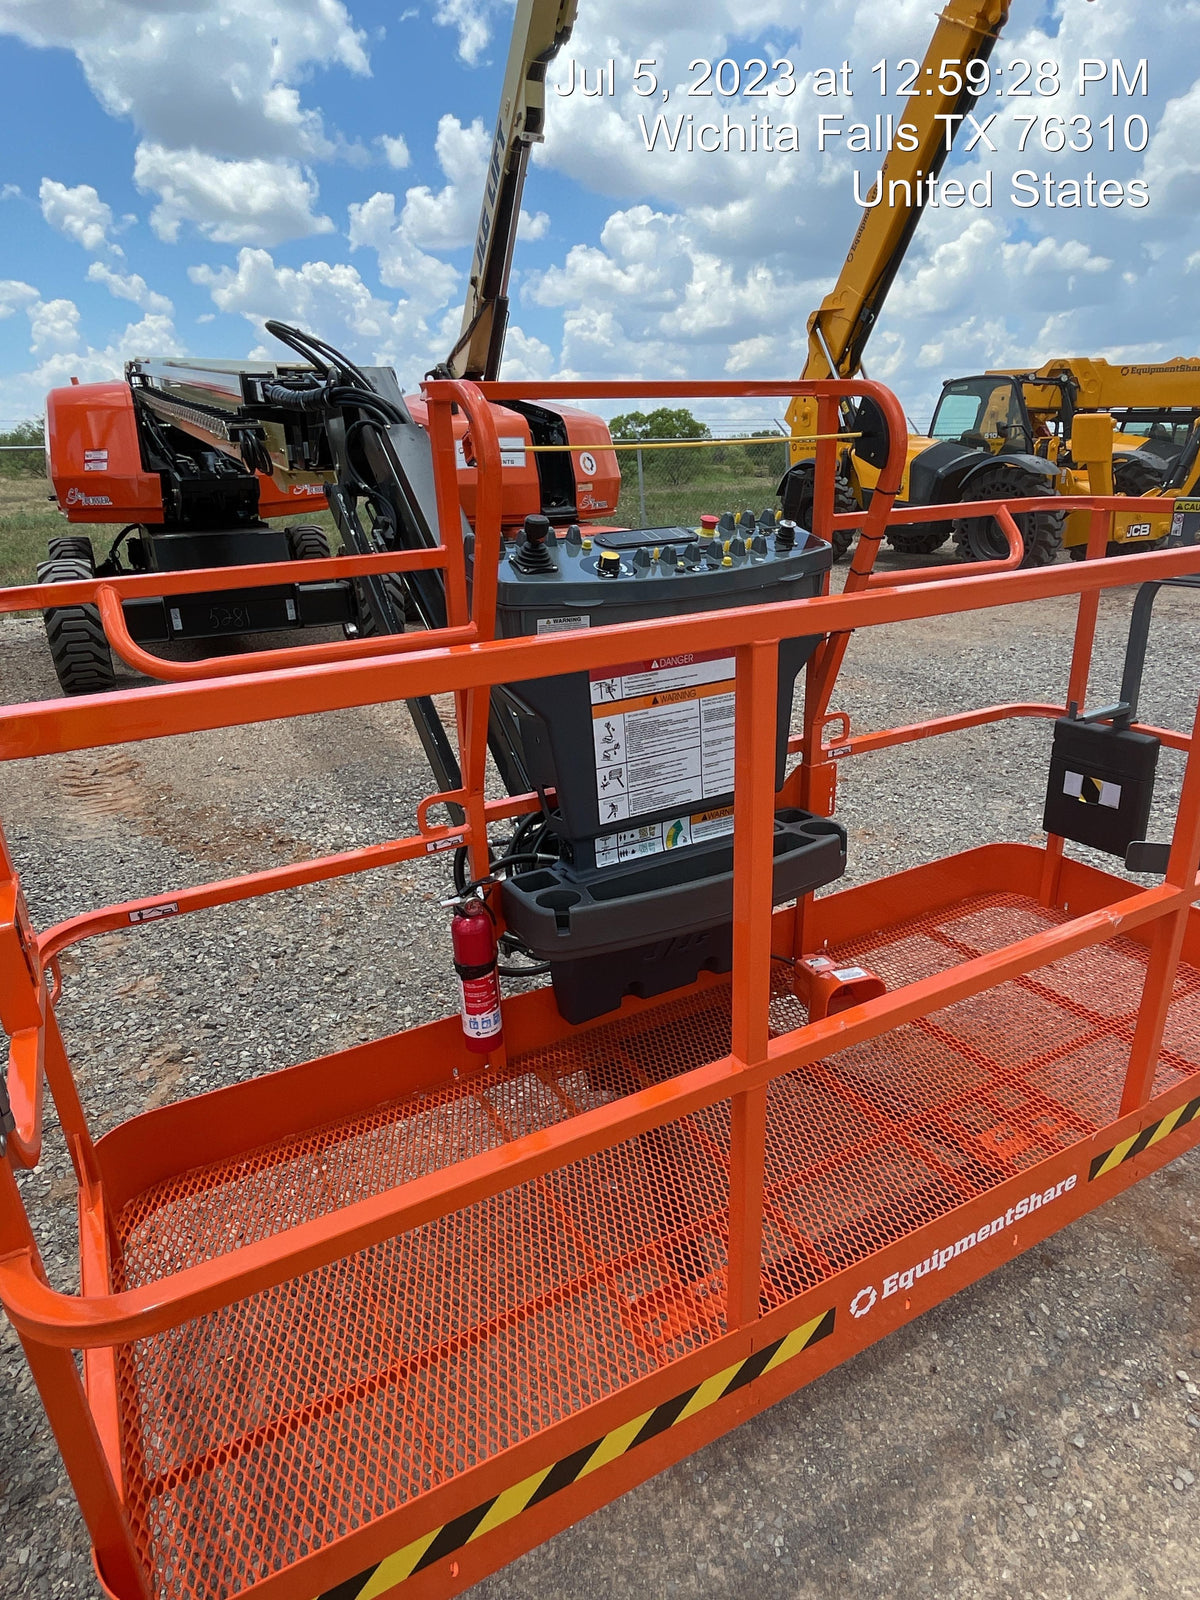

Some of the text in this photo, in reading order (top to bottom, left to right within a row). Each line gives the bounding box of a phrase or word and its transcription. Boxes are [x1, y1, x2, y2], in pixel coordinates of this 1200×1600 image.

[487, 118, 506, 208] LIFT
[1126, 524, 1151, 538] JCB
[209, 605, 251, 628] 5281
[659, 654, 694, 668] DANGER
[660, 689, 697, 704] WARNING
[881, 1173, 1078, 1300] EquipmentShare
